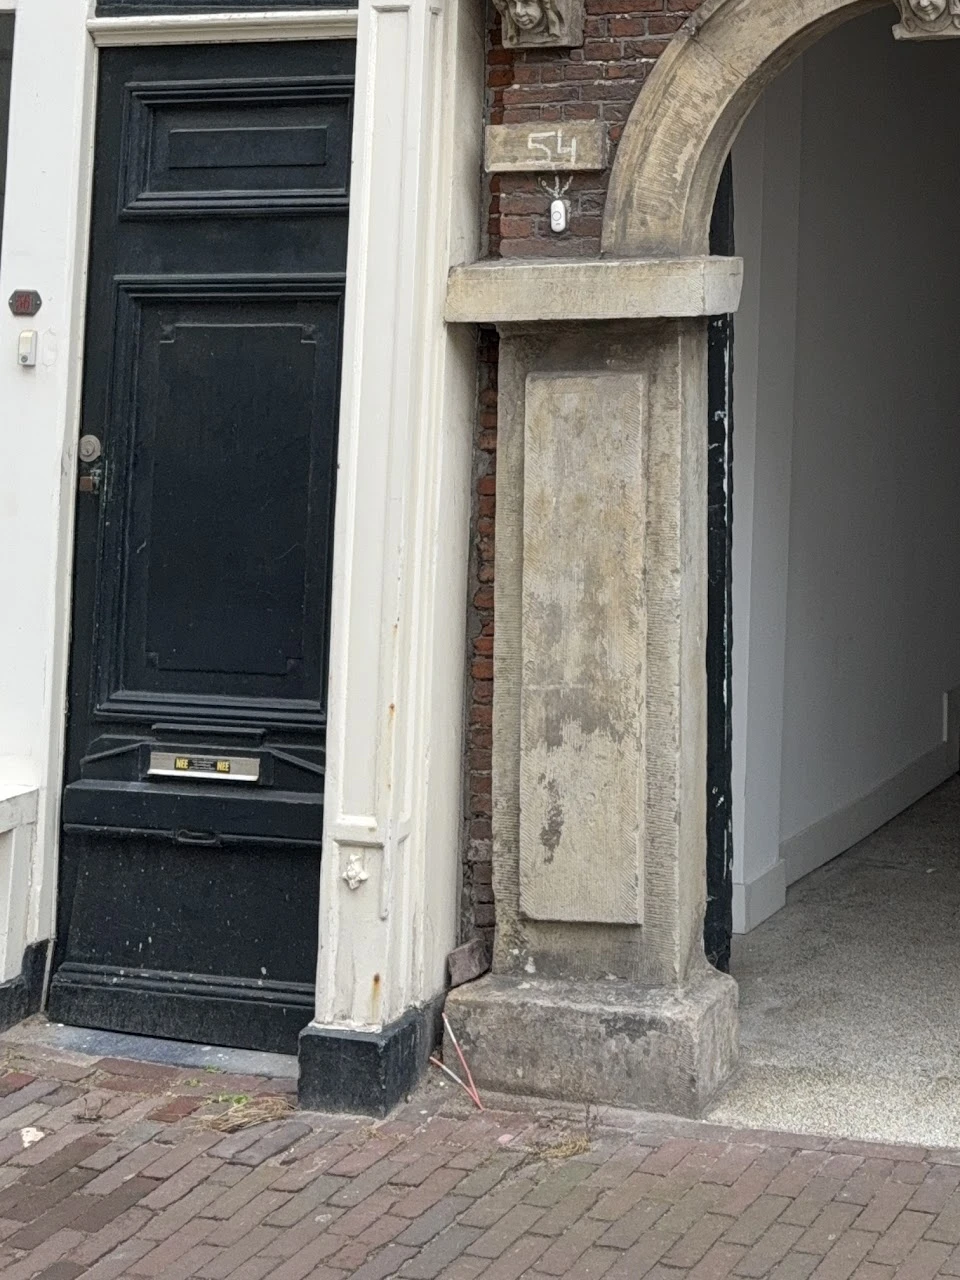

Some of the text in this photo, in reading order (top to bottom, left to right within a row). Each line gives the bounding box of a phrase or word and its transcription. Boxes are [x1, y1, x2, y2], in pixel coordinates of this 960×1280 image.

[528, 129, 576, 164] 54
[176, 758, 188, 768] NEE
[217, 761, 229, 771] NEE
